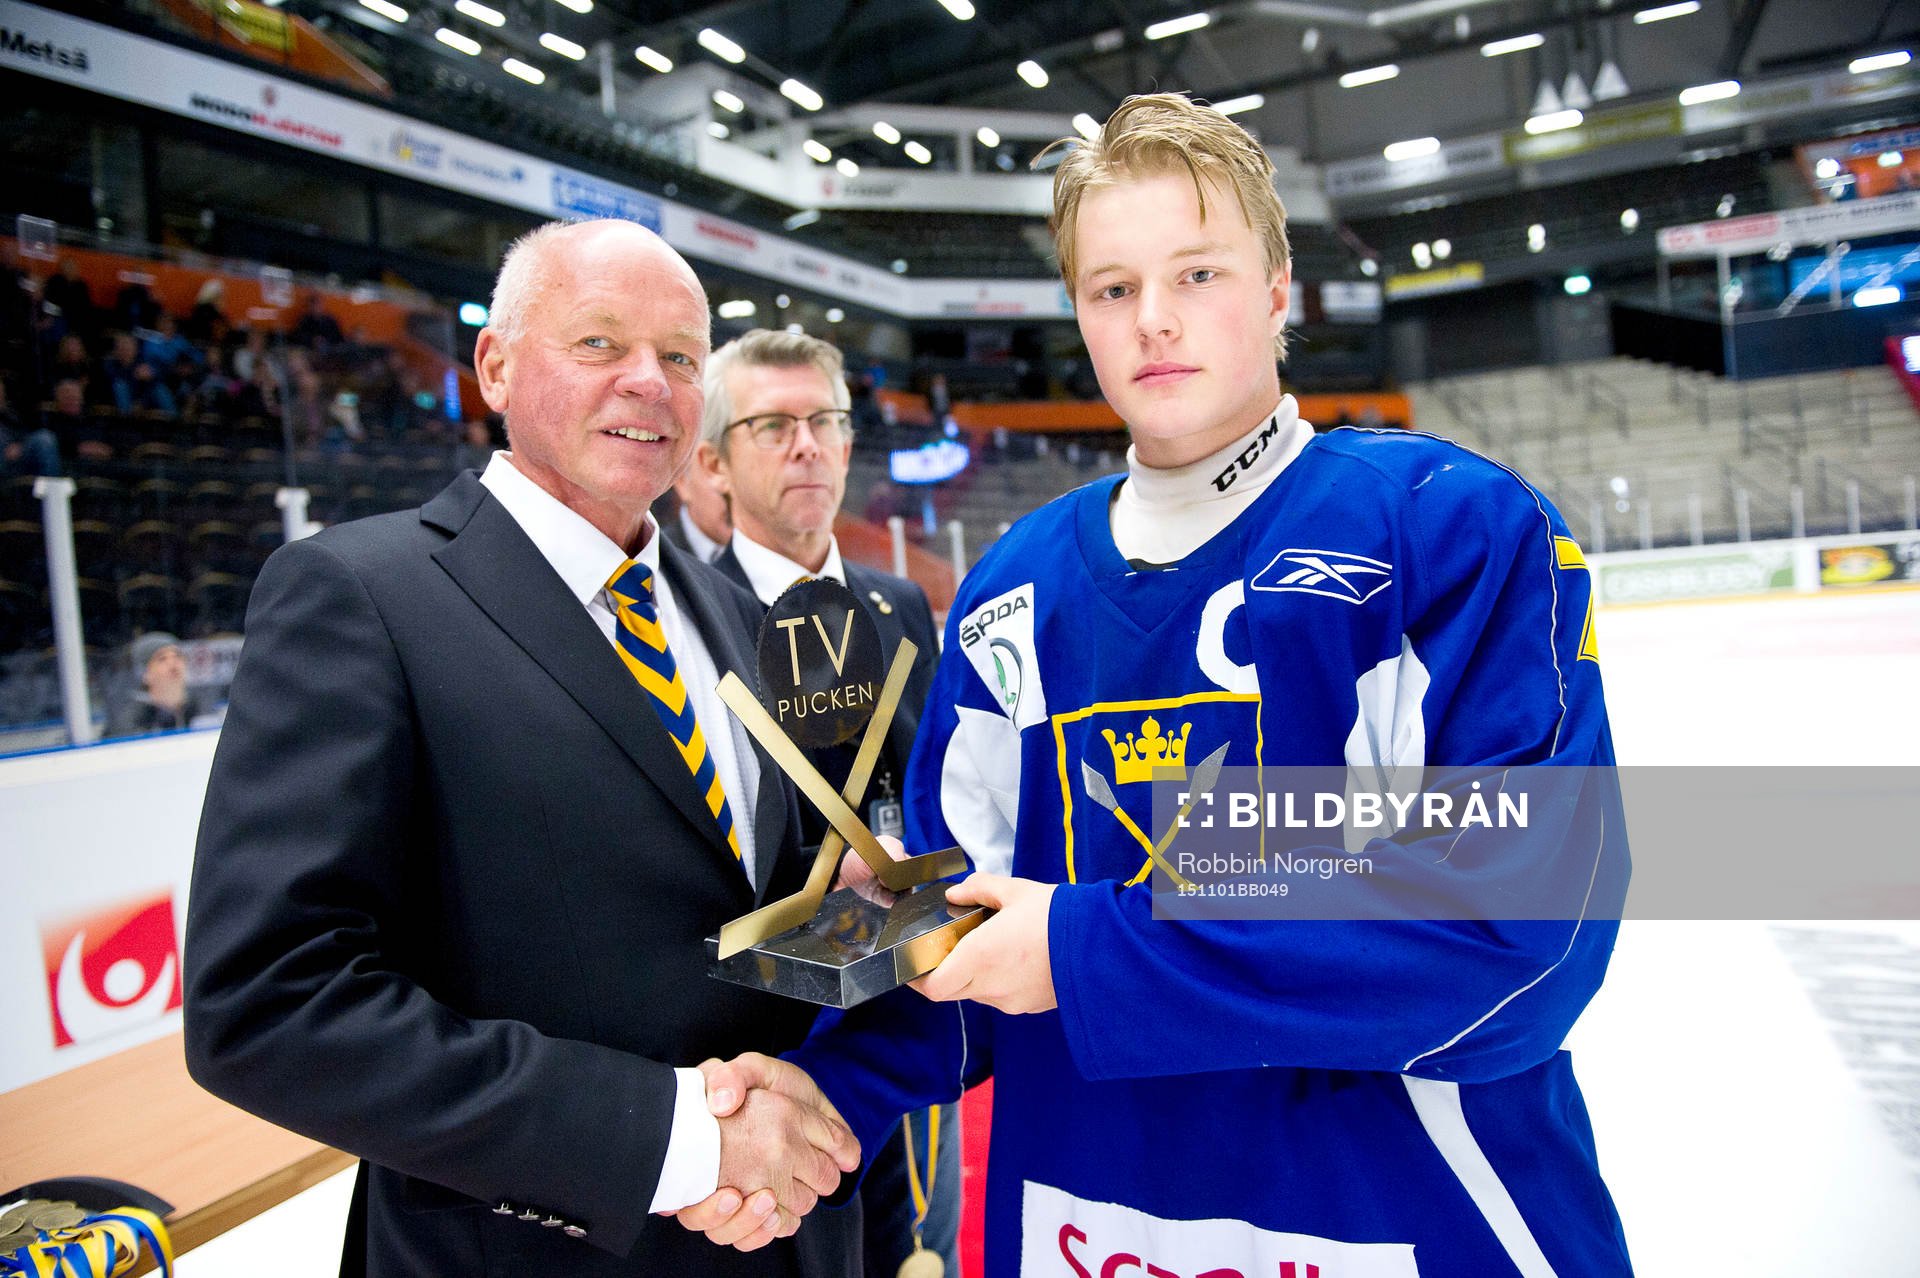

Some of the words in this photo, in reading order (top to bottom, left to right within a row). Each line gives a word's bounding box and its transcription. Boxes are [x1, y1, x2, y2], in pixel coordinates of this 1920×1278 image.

[1211, 416, 1279, 491] CCM
[775, 609, 855, 686] TV
[778, 682, 873, 722] PUCKEN
